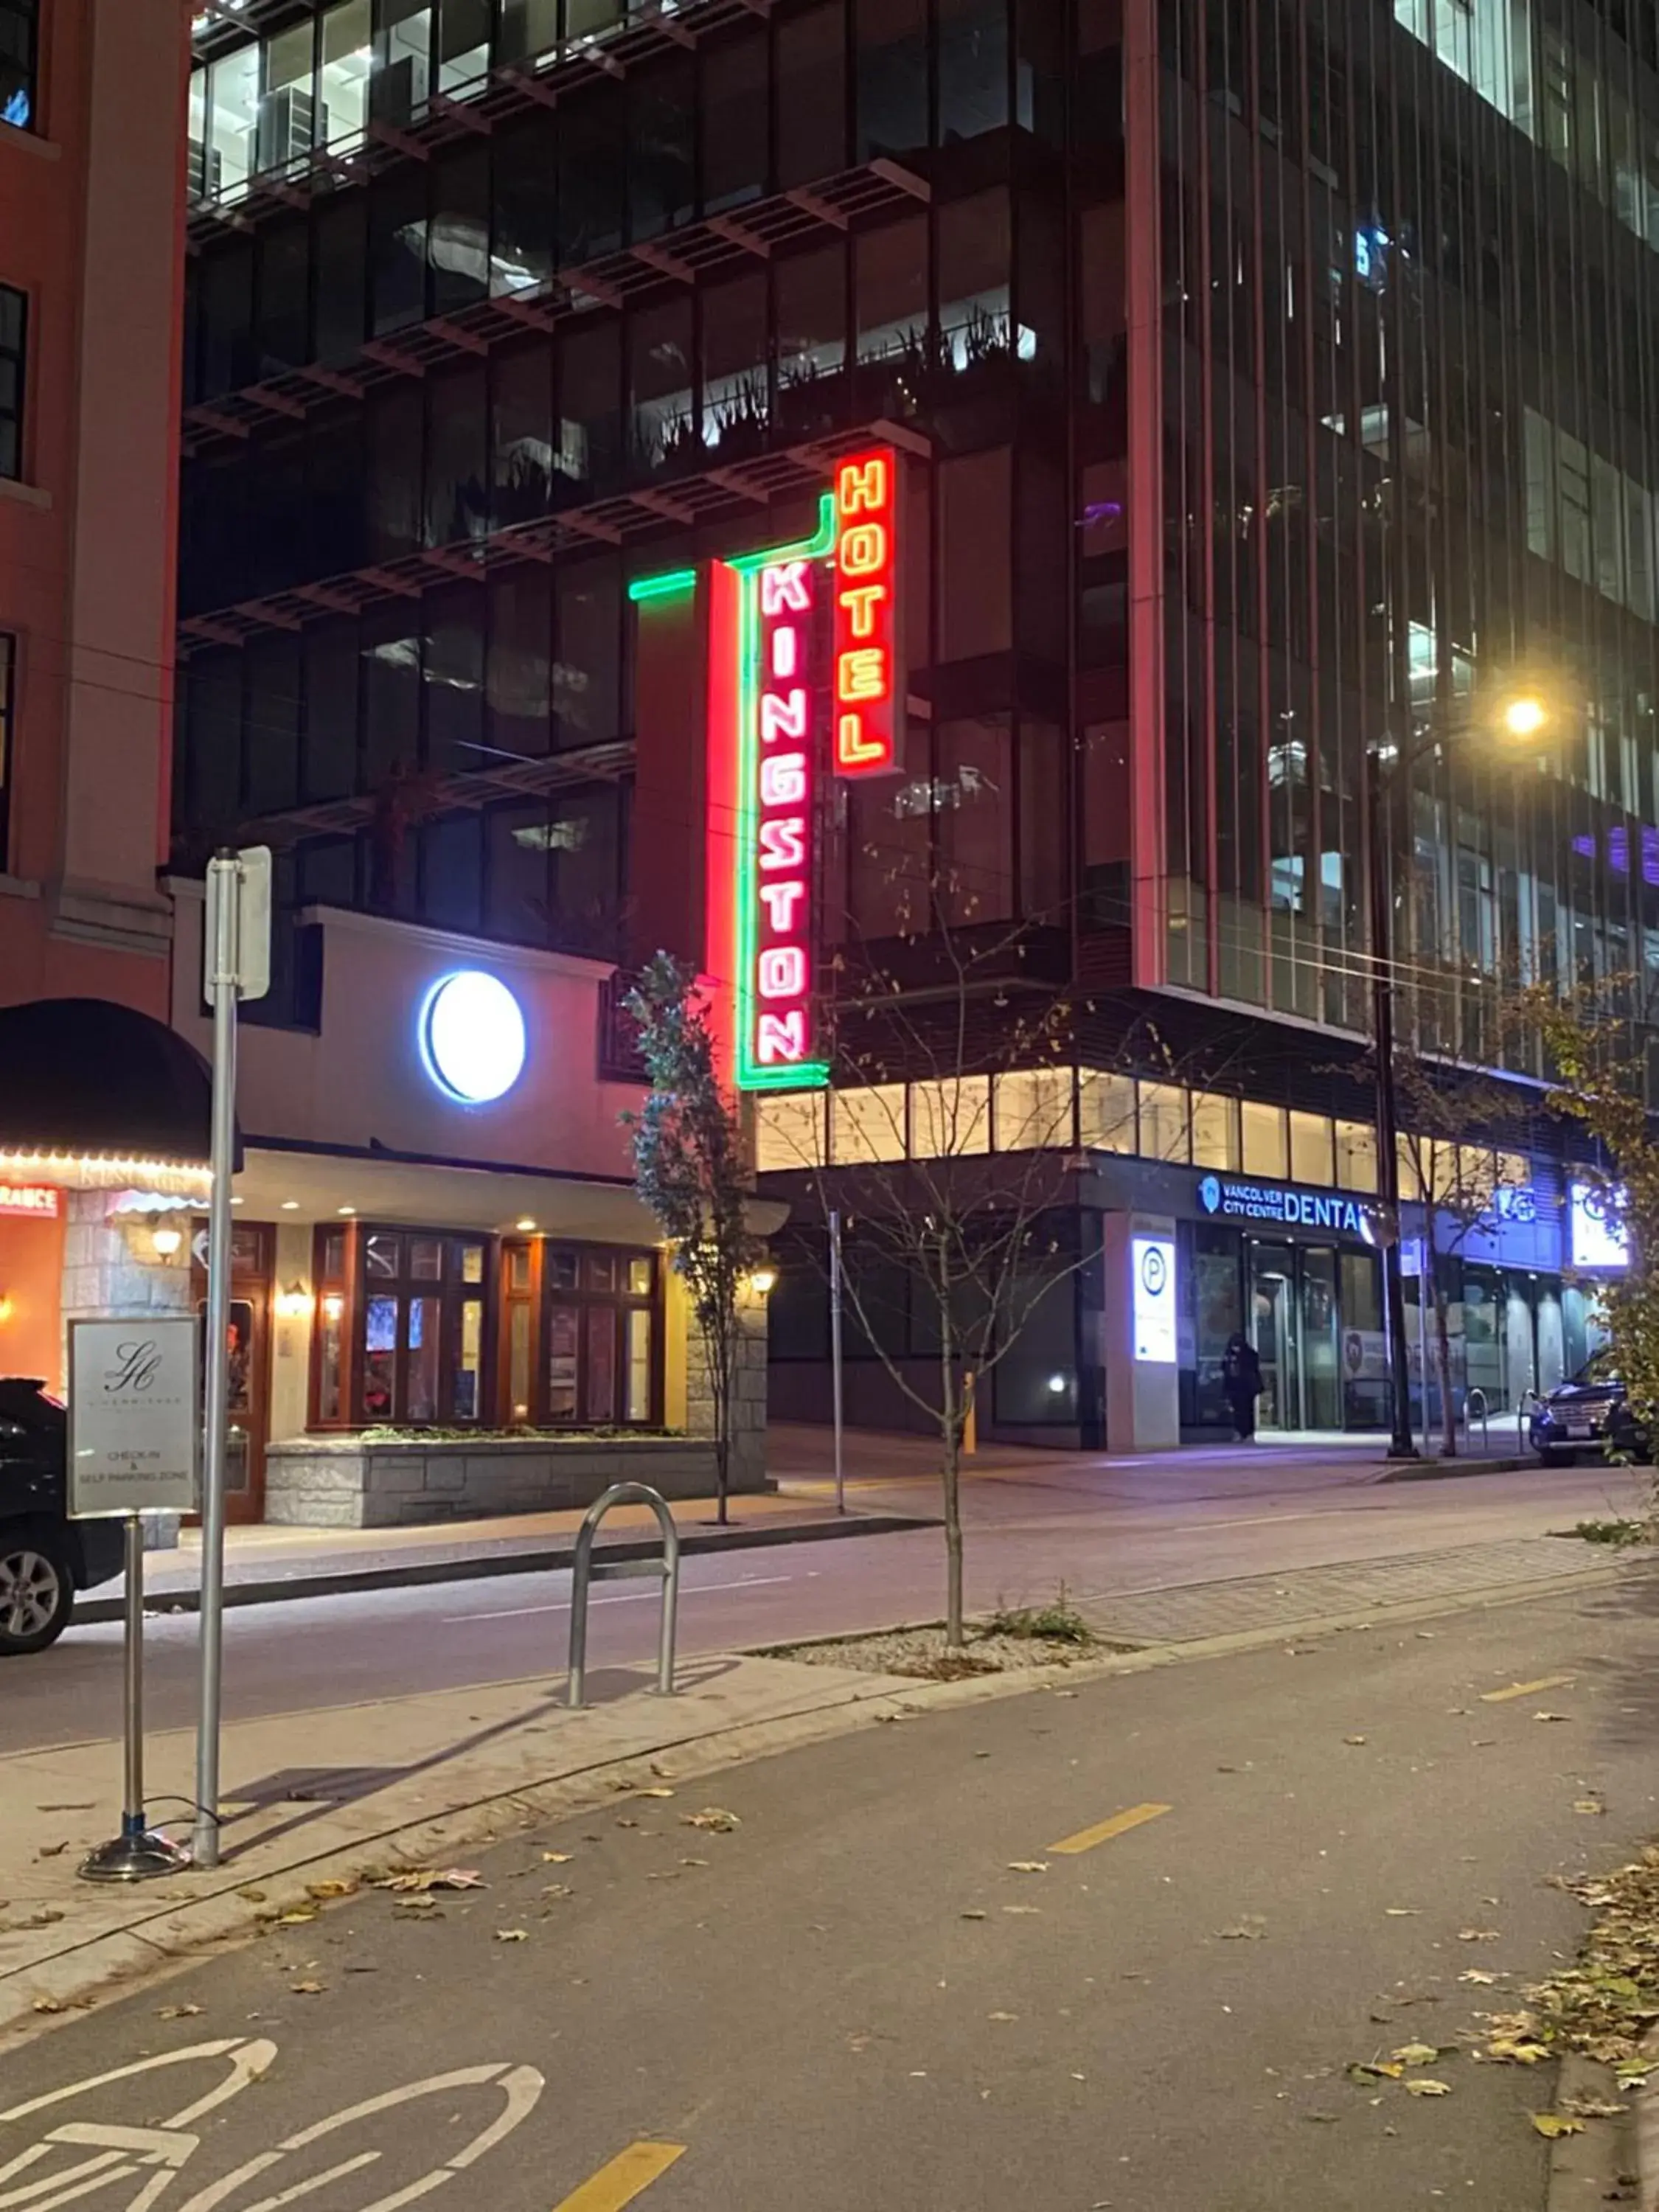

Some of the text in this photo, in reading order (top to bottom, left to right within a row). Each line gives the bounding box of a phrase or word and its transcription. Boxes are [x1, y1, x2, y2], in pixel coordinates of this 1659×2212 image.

[838, 459, 886, 764] HOTEL
[759, 560, 810, 1064] KINGSTON
[1223, 1200, 1284, 1221] CITY CENTRE
